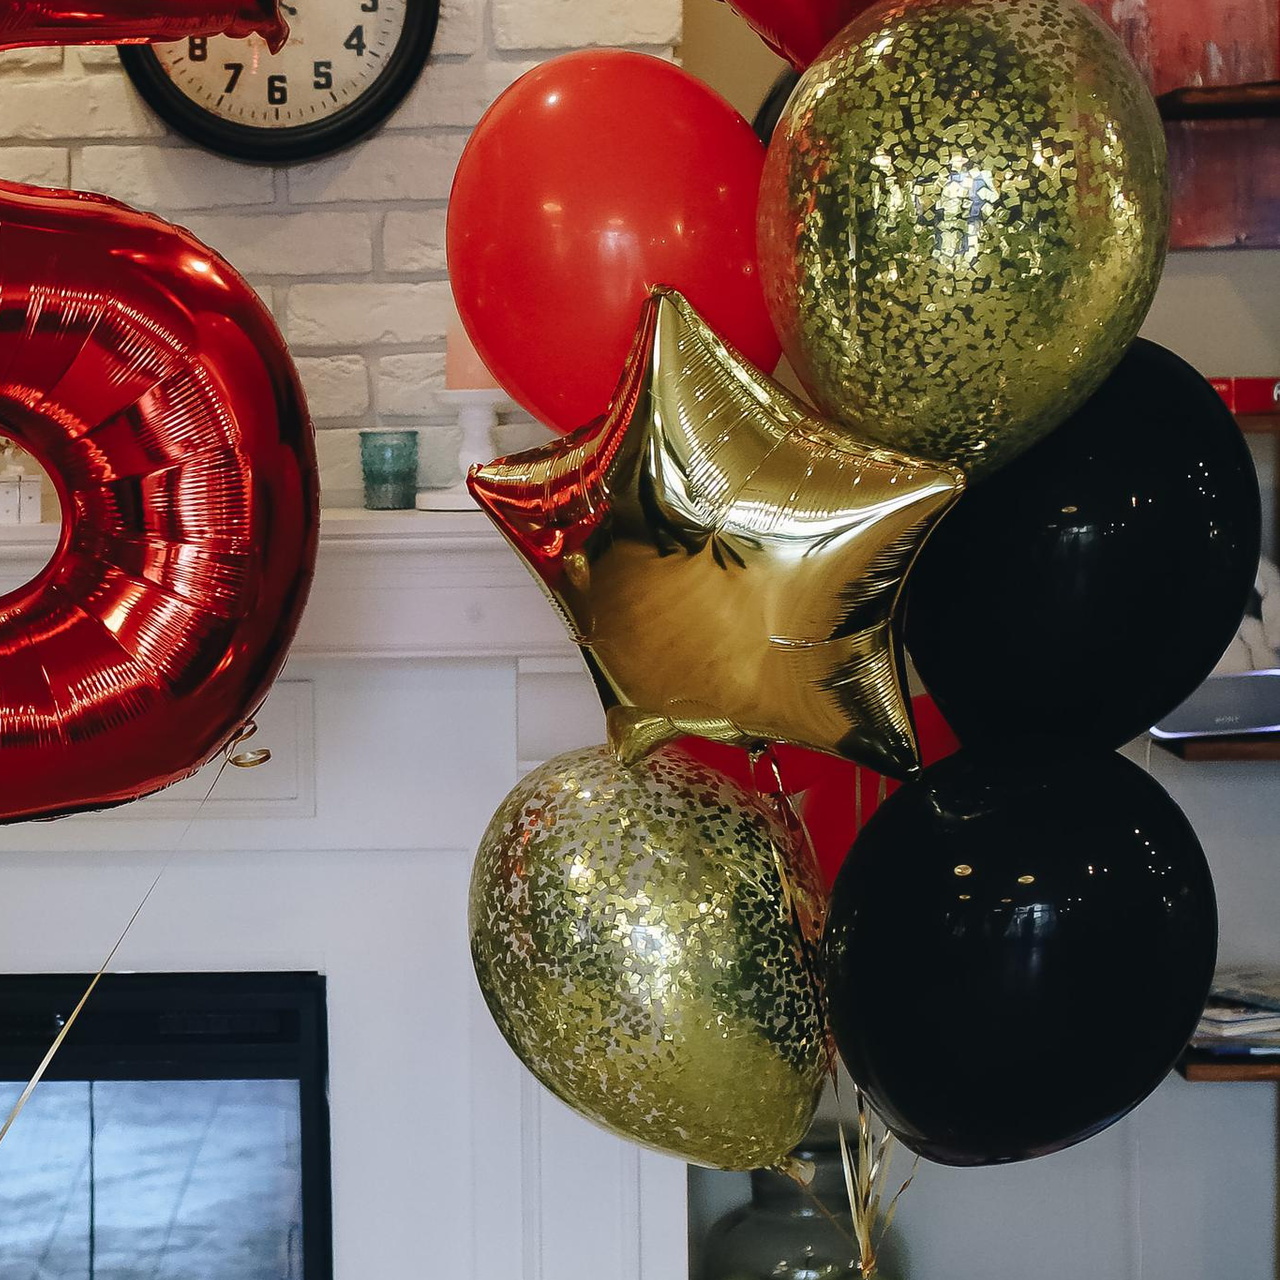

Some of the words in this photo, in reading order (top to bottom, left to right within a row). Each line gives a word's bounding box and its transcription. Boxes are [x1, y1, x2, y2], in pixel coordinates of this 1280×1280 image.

[188, 35, 208, 62] 8
[343, 25, 367, 57] 4
[223, 62, 244, 93] 7
[267, 74, 288, 105] 6
[313, 61, 332, 89] 5
